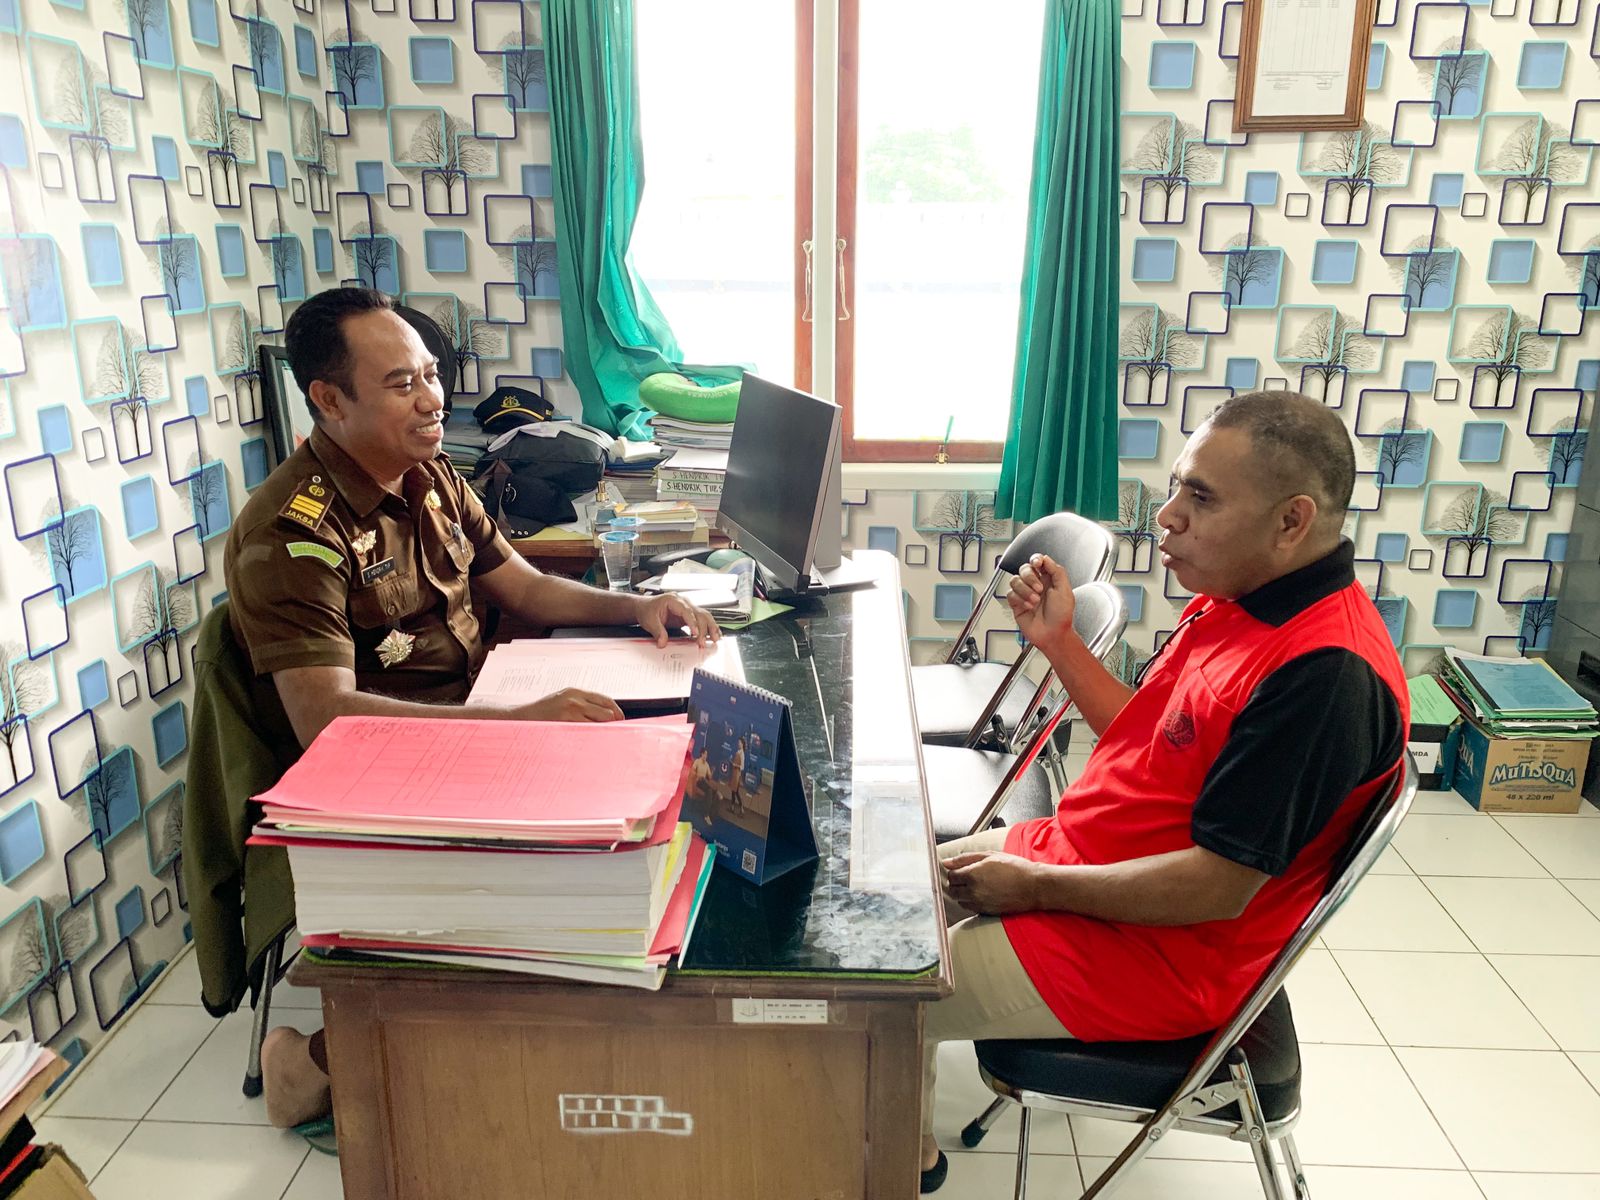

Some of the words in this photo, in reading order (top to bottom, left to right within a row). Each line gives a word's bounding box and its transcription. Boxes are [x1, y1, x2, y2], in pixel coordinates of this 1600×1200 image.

[285, 510, 314, 527] JAKSA
[1506, 793, 1517, 801] 48
[1542, 793, 1555, 801] ml
